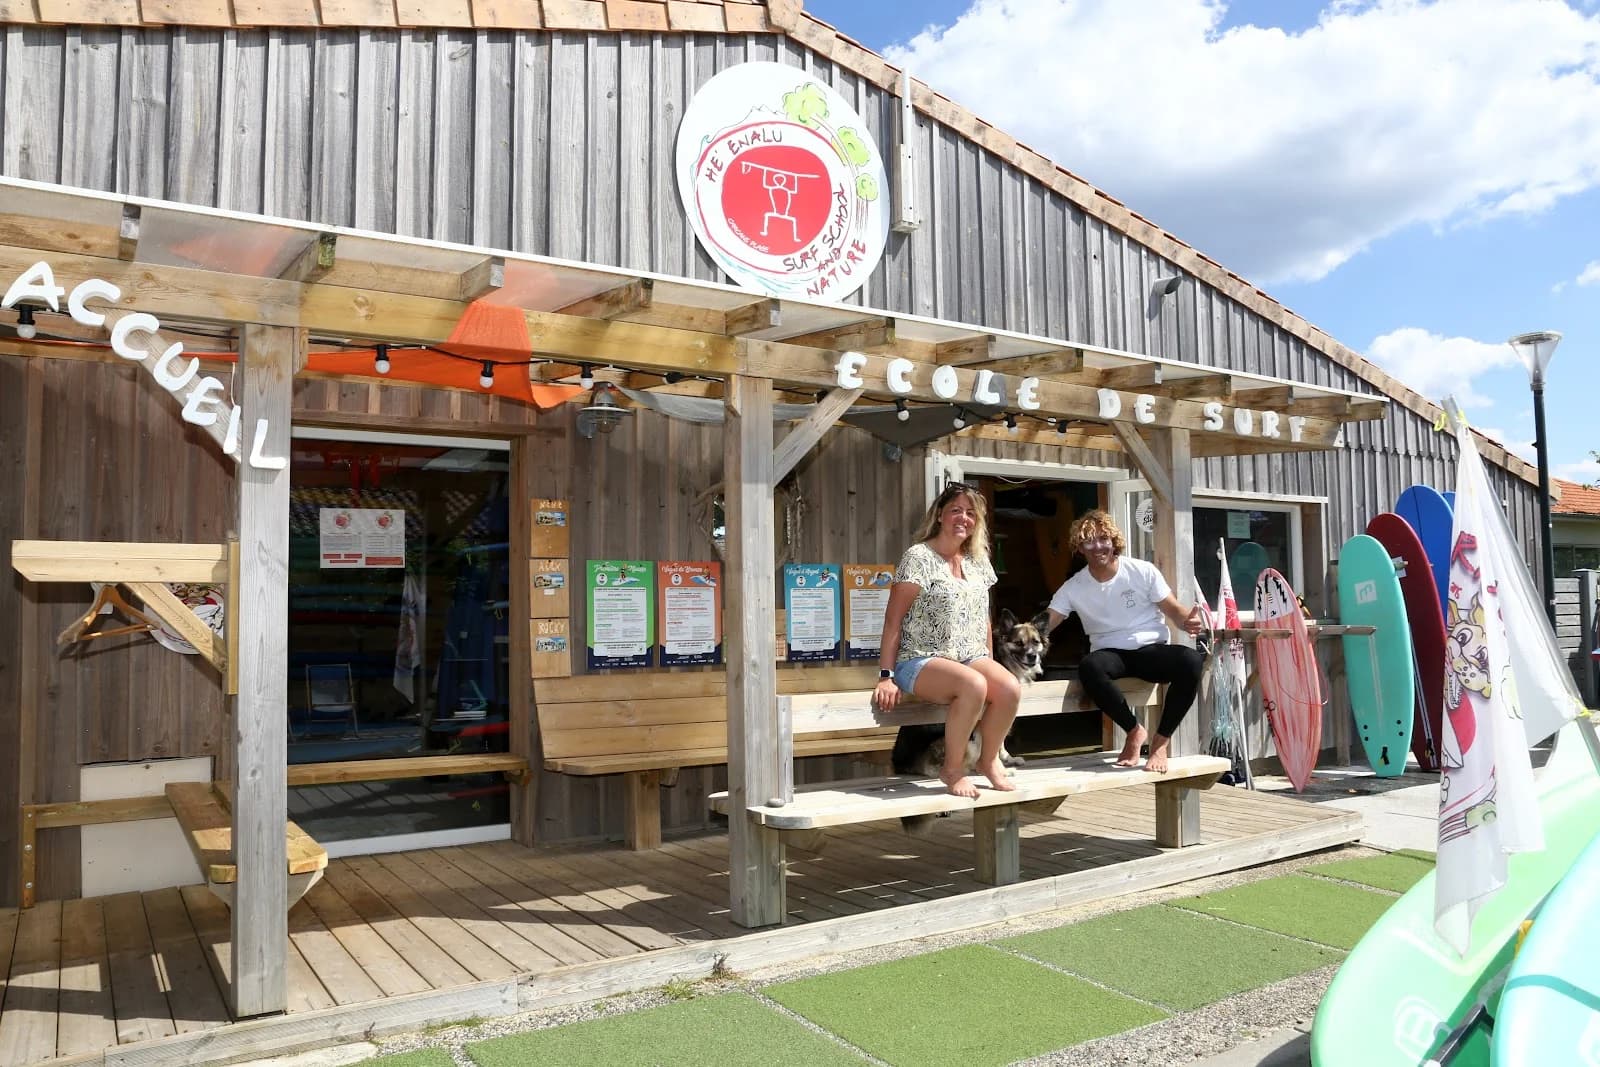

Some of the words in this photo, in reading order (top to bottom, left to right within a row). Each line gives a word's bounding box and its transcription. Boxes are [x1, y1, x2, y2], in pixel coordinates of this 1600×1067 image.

[727, 127, 783, 155] ENALU
[782, 244, 819, 272] SURF
[806, 238, 867, 296] NATURE
[817, 247, 841, 273] AND
[1, 260, 288, 470] ACCUEIL
[834, 351, 1041, 411] ECOLE
[1096, 387, 1157, 425] DE
[1203, 402, 1307, 443] SURF
